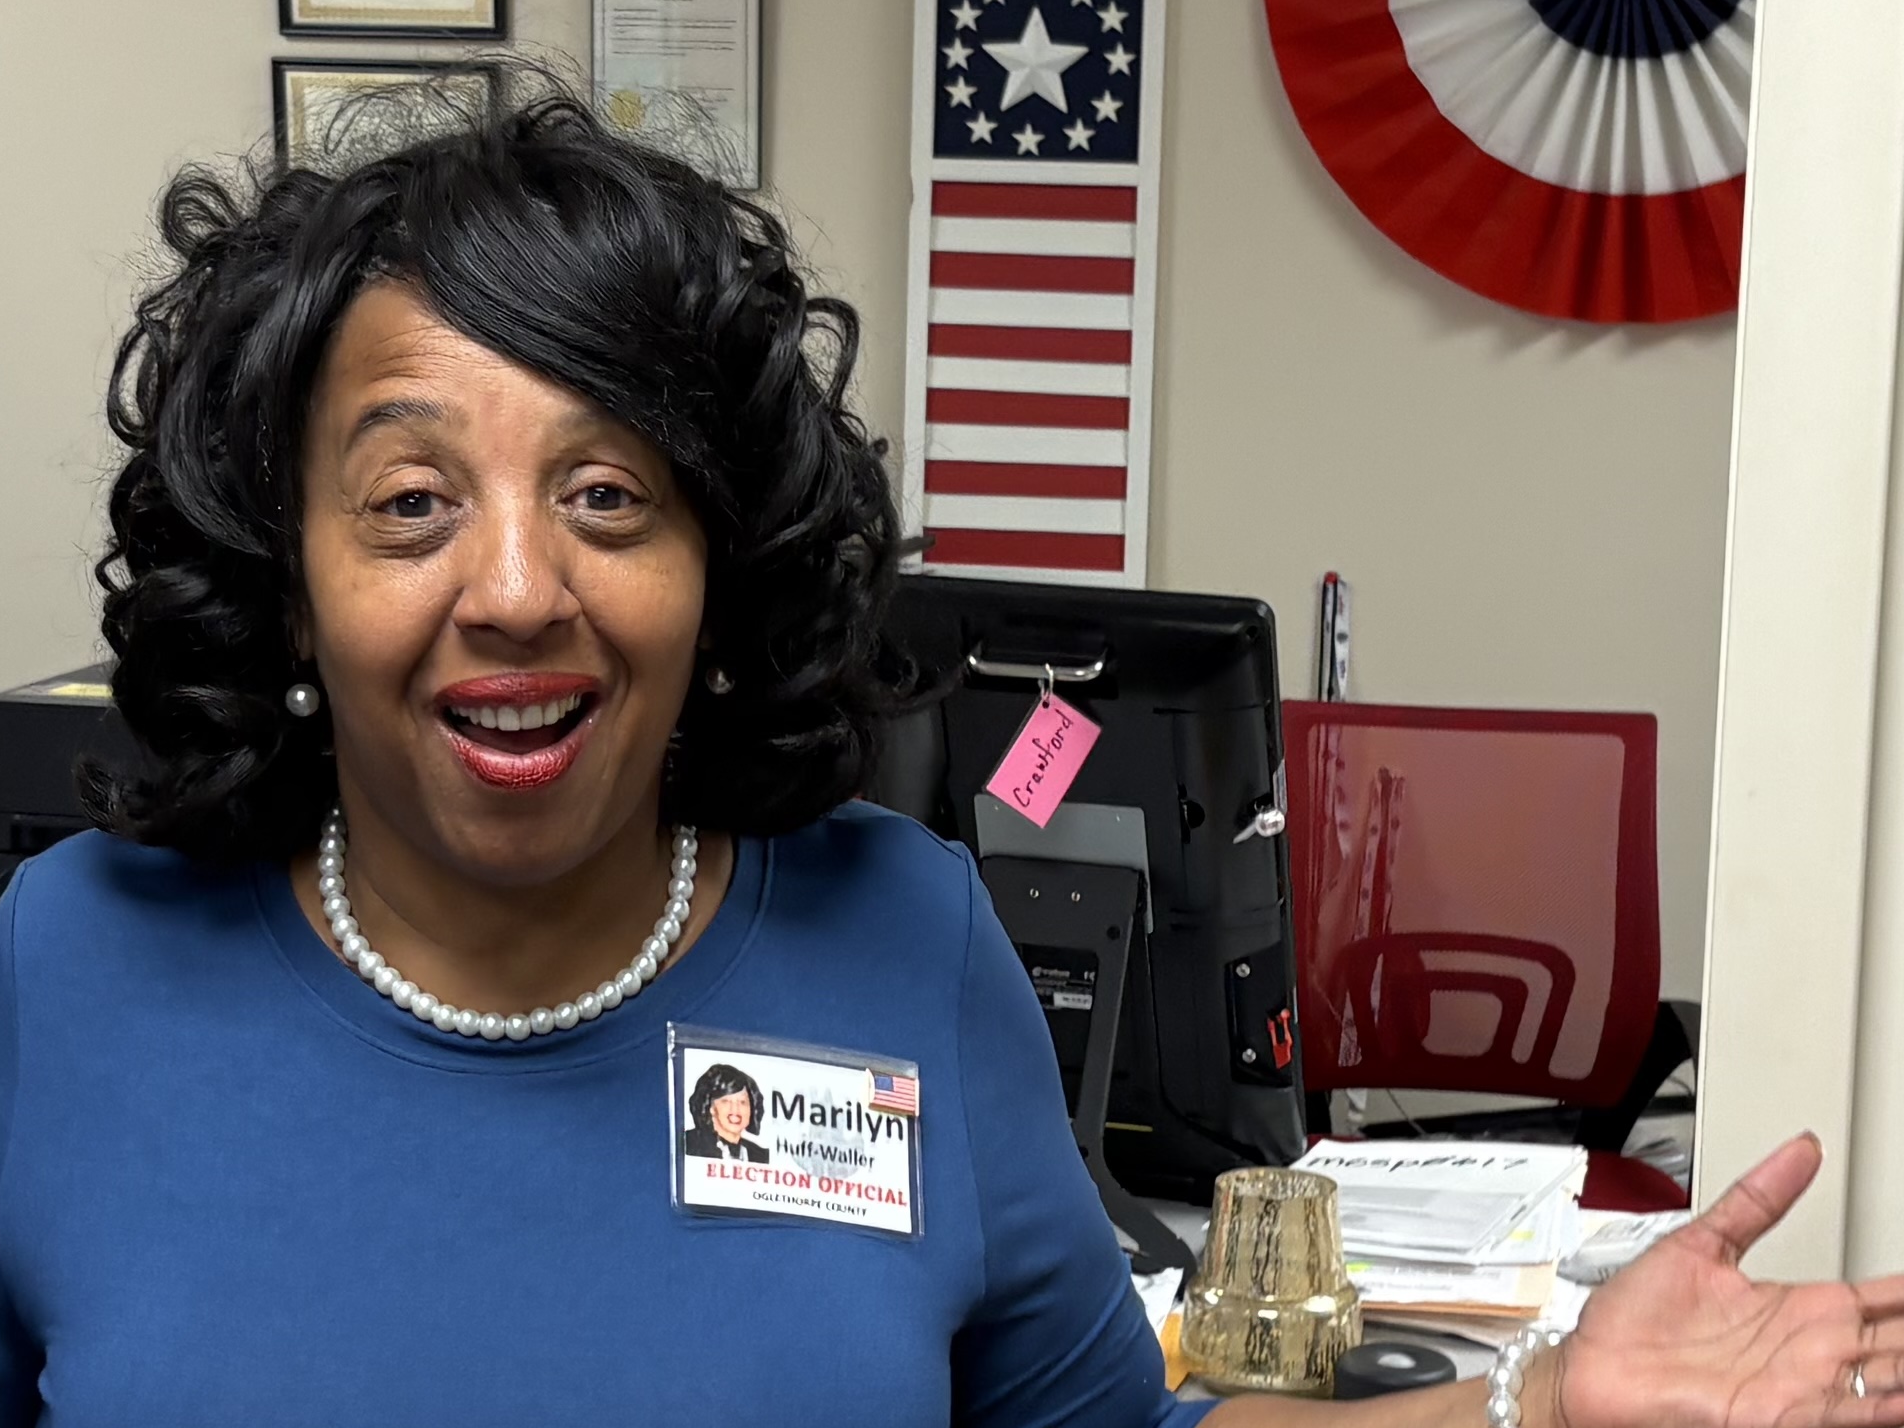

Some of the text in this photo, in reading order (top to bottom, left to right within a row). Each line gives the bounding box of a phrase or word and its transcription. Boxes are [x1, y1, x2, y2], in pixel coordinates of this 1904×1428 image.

[771, 1089, 904, 1143] Marilyn
[776, 1135, 875, 1170] Huff-Waller
[706, 1164, 908, 1208] ELECTION OFFICIAL
[752, 1191, 868, 1218] OGLETHORPE COUNTY
